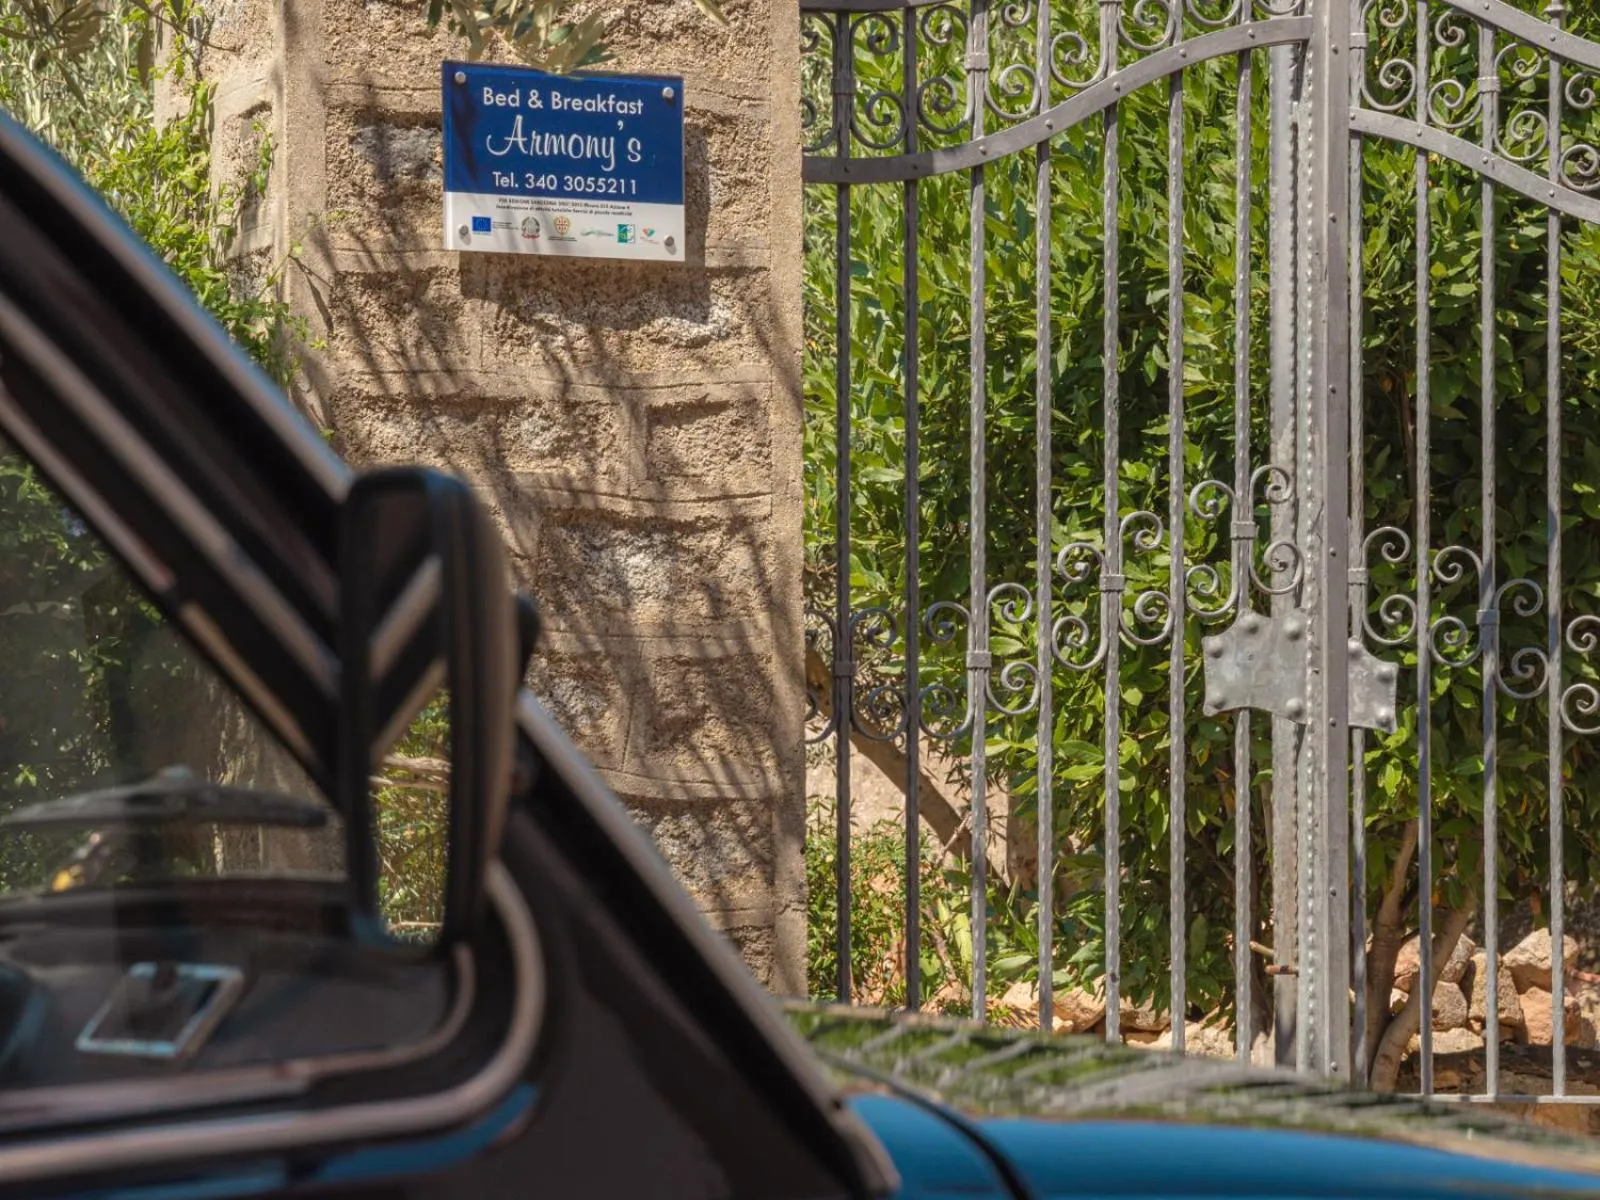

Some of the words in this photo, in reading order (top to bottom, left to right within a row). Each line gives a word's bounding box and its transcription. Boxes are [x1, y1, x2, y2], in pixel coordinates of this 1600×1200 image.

[483, 87, 520, 107] Bed
[527, 89, 543, 109] &
[551, 91, 643, 114] Breakfast
[486, 114, 642, 172] Armony's
[492, 172, 518, 188] Tel.
[525, 173, 557, 190] 340
[563, 175, 636, 195] 3055211
